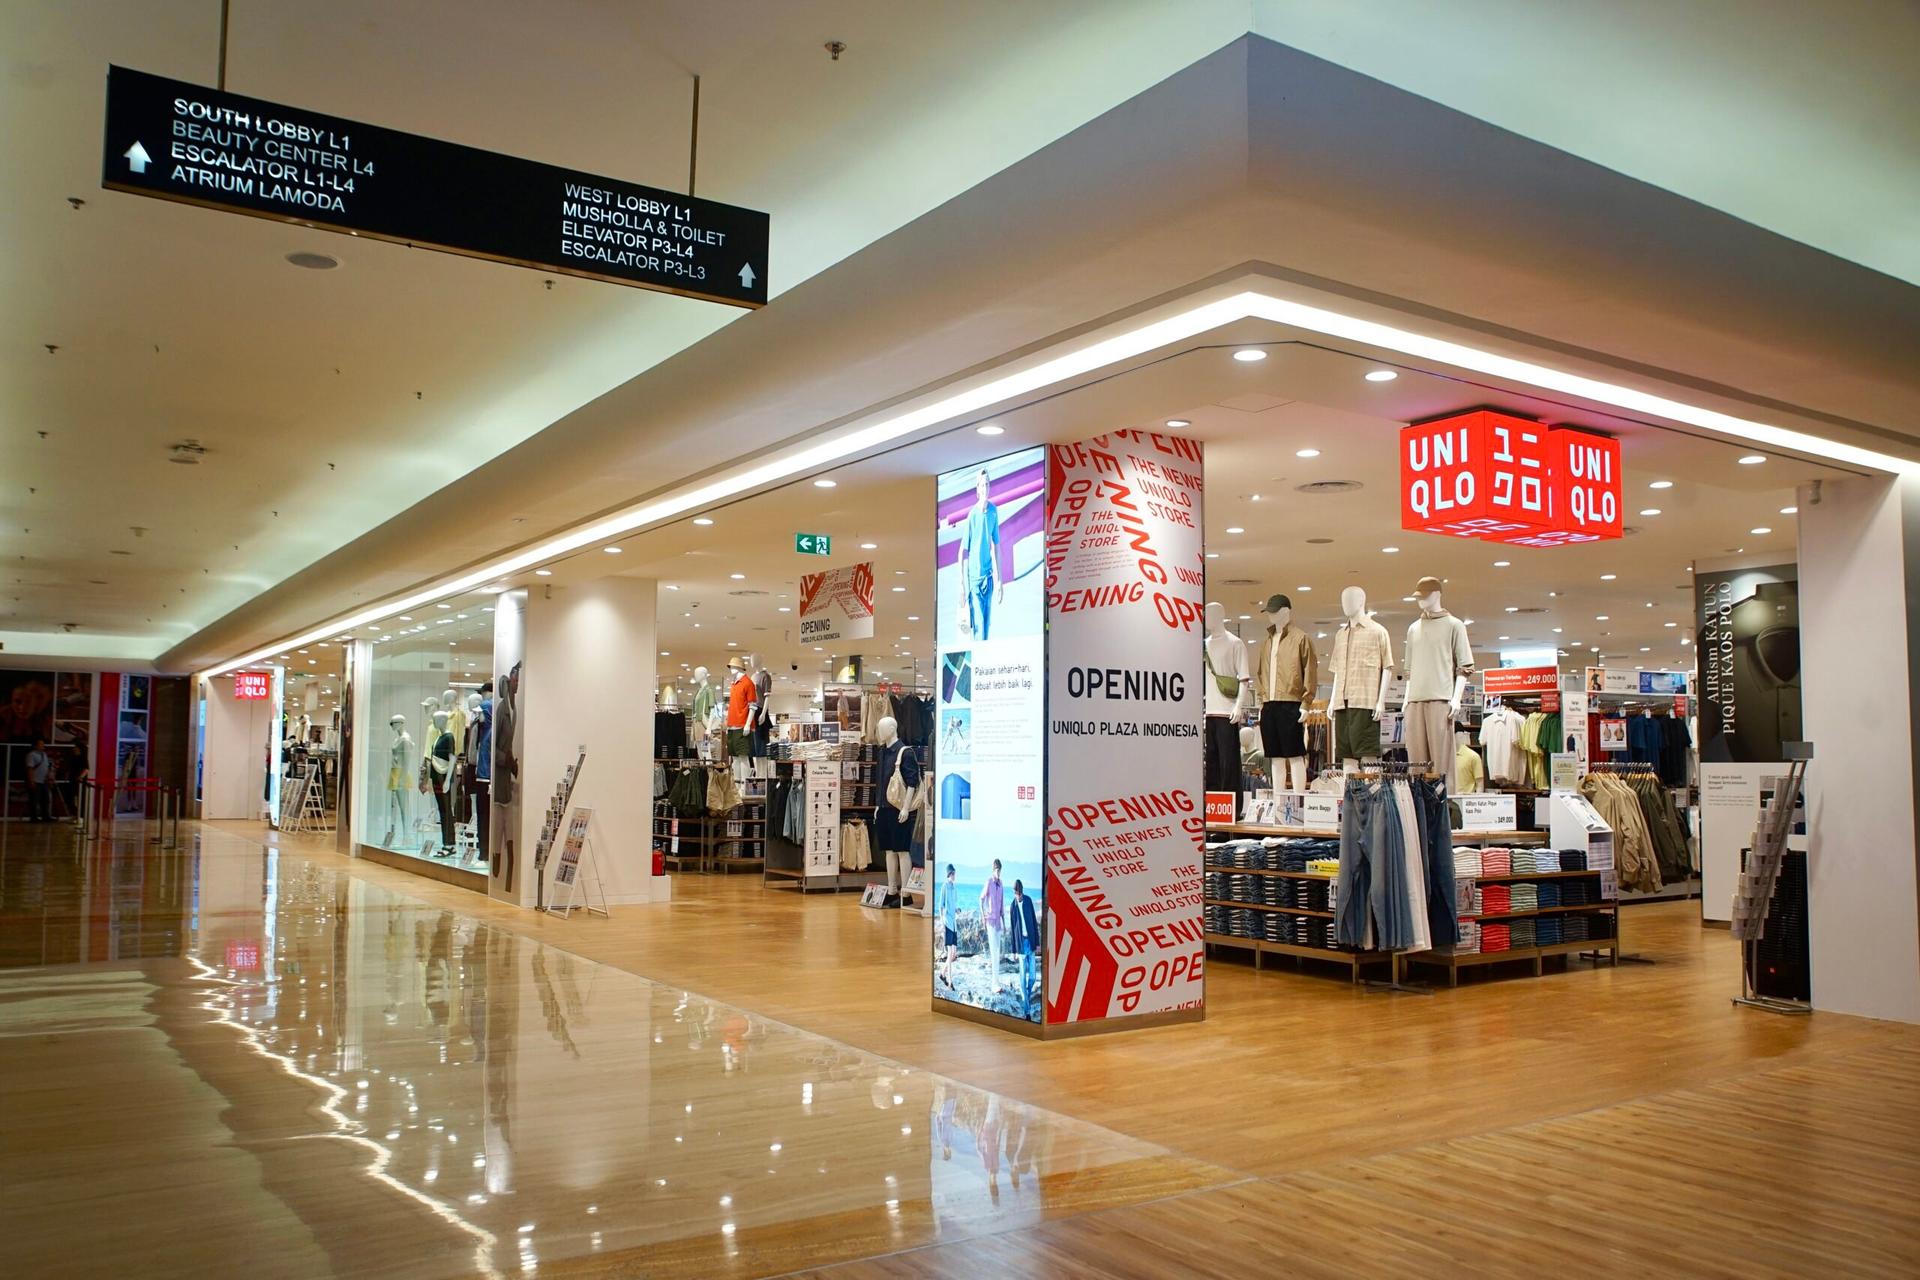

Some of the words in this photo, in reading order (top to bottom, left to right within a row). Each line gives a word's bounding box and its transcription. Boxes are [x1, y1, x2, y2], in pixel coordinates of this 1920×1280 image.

[173, 97, 250, 130] SOUTH
[256, 116, 324, 145] LOBBY
[329, 132, 350, 151] L1
[171, 142, 299, 183] ESCALATOR
[304, 170, 355, 193] L1-L4
[172, 119, 259, 152] BEAUTY
[264, 138, 348, 171] CENTER
[353, 158, 375, 177] L4
[171, 164, 253, 195] ATRIUM
[259, 181, 345, 213] LAMODA
[564, 182, 613, 205] WEST
[616, 192, 671, 217] LOBBY
[674, 205, 691, 221] L1
[562, 220, 647, 250] ELEVATOR
[652, 237, 694, 259] P3-L4
[563, 201, 654, 233] MUSHOLLA
[657, 221, 668, 236] &
[671, 223, 726, 247] TOILET
[561, 240, 660, 272] ESCALATOR
[664, 258, 706, 280] P3-L3
[1126, 454, 1160, 478] THE
[1409, 428, 1468, 472] UNI
[1569, 443, 1611, 484] UNI
[1136, 477, 1192, 508] UNIQLO
[1410, 470, 1475, 519] QLO
[1570, 485, 1616, 526] QLO
[1146, 501, 1196, 529] STORE
[1079, 535, 1120, 549] STORE
[1704, 583, 1718, 643] KATUN
[1718, 581, 1733, 627] POLO
[801, 618, 831, 635] OPENING
[1720, 630, 1734, 677] KAOS
[245, 676, 266, 686] UNI
[245, 686, 267, 696] QLO
[1067, 666, 1185, 702] OPENING
[1527, 674, 1557, 684] 249.000
[1707, 646, 1720, 704] AIRism
[1722, 678, 1736, 735] PIQUE
[1052, 720, 1095, 736] UNIQLO
[1100, 722, 1139, 736] PLAZA
[1143, 723, 1199, 737] INDONESIA
[1057, 789, 1195, 832] OPENING
[1206, 803, 1232, 815] 49.000
[1083, 836, 1117, 851] THE
[1117, 825, 1175, 846] NEWEST
[1093, 846, 1145, 864] UNIQLO
[1102, 861, 1149, 878] STORE
[1170, 864, 1199, 879] THE
[1128, 898, 1176, 918] UNIQLO
[1117, 965, 1147, 1013] OP
[1149, 951, 1204, 991] OPE
